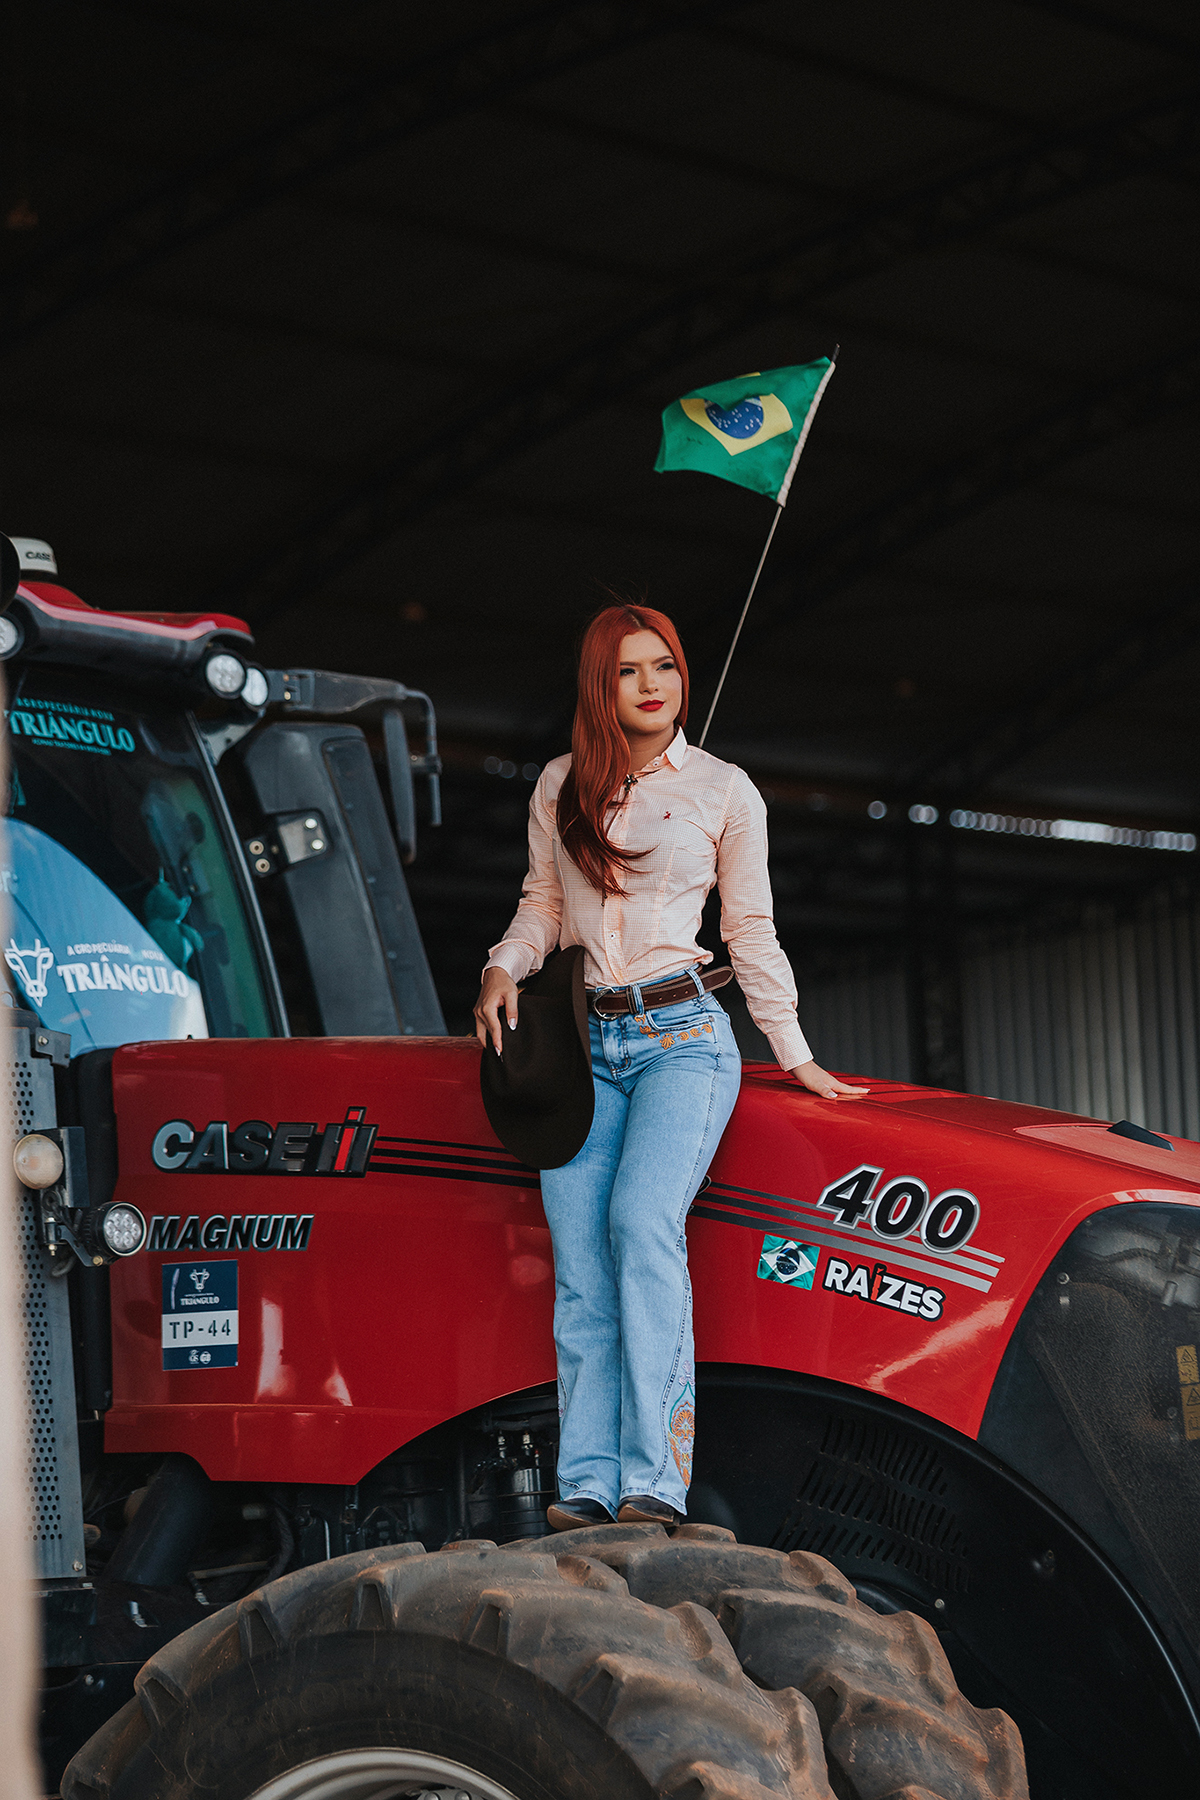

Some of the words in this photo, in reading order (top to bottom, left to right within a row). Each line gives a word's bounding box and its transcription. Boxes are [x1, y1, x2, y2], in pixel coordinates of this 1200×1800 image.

[25, 551, 51, 562] CASE
[3, 709, 136, 753] TRIÂNGULO
[56, 954, 190, 998] TRIÂNGULO
[152, 1119, 317, 1173] CASE
[816, 1163, 981, 1254] 400
[145, 1214, 315, 1252] MAGNUM
[169, 1319, 231, 1339] TP-44
